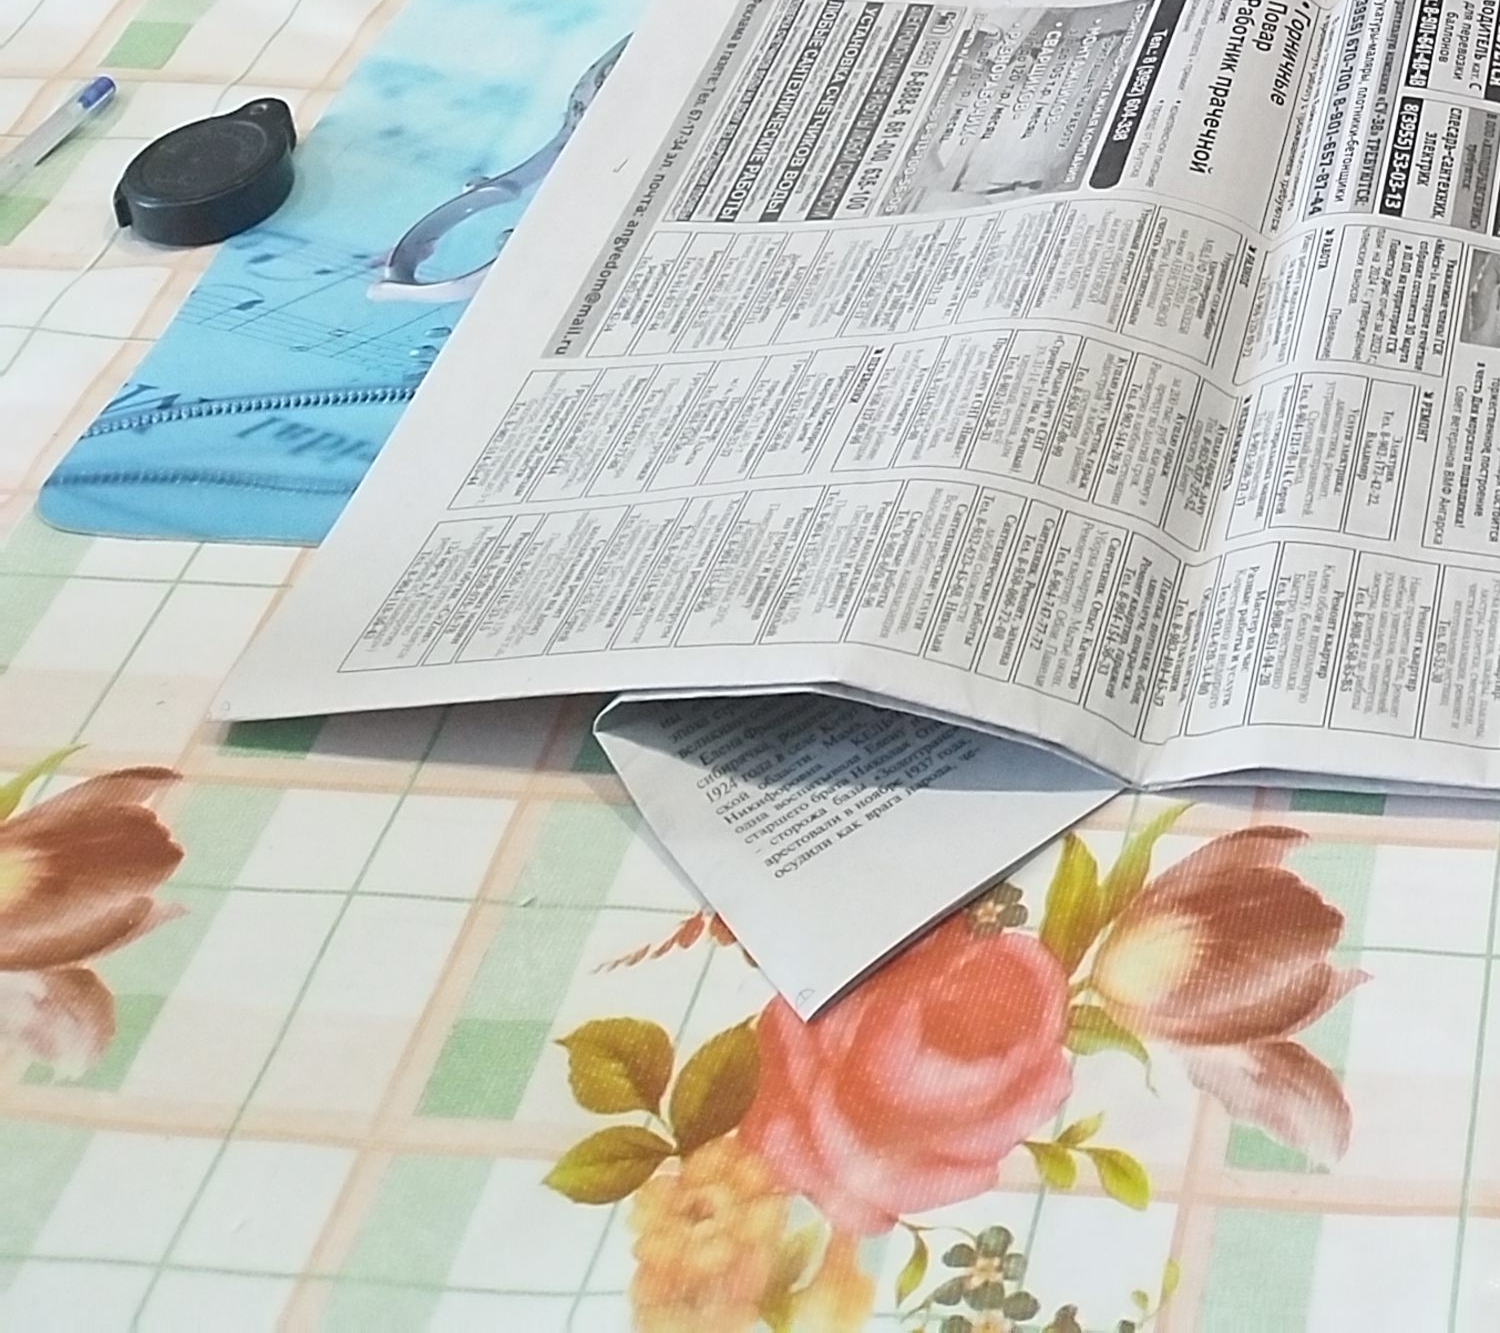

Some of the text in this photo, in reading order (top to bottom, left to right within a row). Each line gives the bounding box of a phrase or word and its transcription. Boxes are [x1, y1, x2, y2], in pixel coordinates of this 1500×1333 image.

[830, 7, 879, 83] УСТАНОВКА
[1252, 1, 1287, 51] Повар
[1438, 12, 1459, 63] баллонов
[1453, 1, 1475, 80] для перевозки
[1474, 0, 1496, 60] ВОДИТЕЛЬ
[1269, 9, 1312, 106] Горничные
[669, 109, 702, 151] 67-17-34
[719, 0, 842, 220] ЛЮБЫЕ САНТЕХНИЧЕСКИЕ РАБОТЫ
[1113, 99, 1141, 141] 604-338
[1189, 76, 1233, 173] прачечной
[1308, 98, 1345, 216] 8-901-657-87-44
[1384, 103, 1419, 209] 8(3955) 53-03-13
[1416, 132, 1438, 186] электрик
[631, 174, 666, 217] почта:
[766, 170, 800, 214] ВОДЫ
[554, 220, 639, 355] angvedom@mail.ru
[1416, 402, 1432, 443] РЕМОНТ
[1474, 377, 1500, 516] торжественное построение
[1432, 386, 1467, 545] Совет ветеранов ВМФ Ангарска
[706, 778, 738, 804] 1924
[743, 802, 809, 844] старшего
[764, 813, 842, 867] арестовали
[769, 806, 828, 846] сторожа
[774, 796, 903, 878] осудили врага
